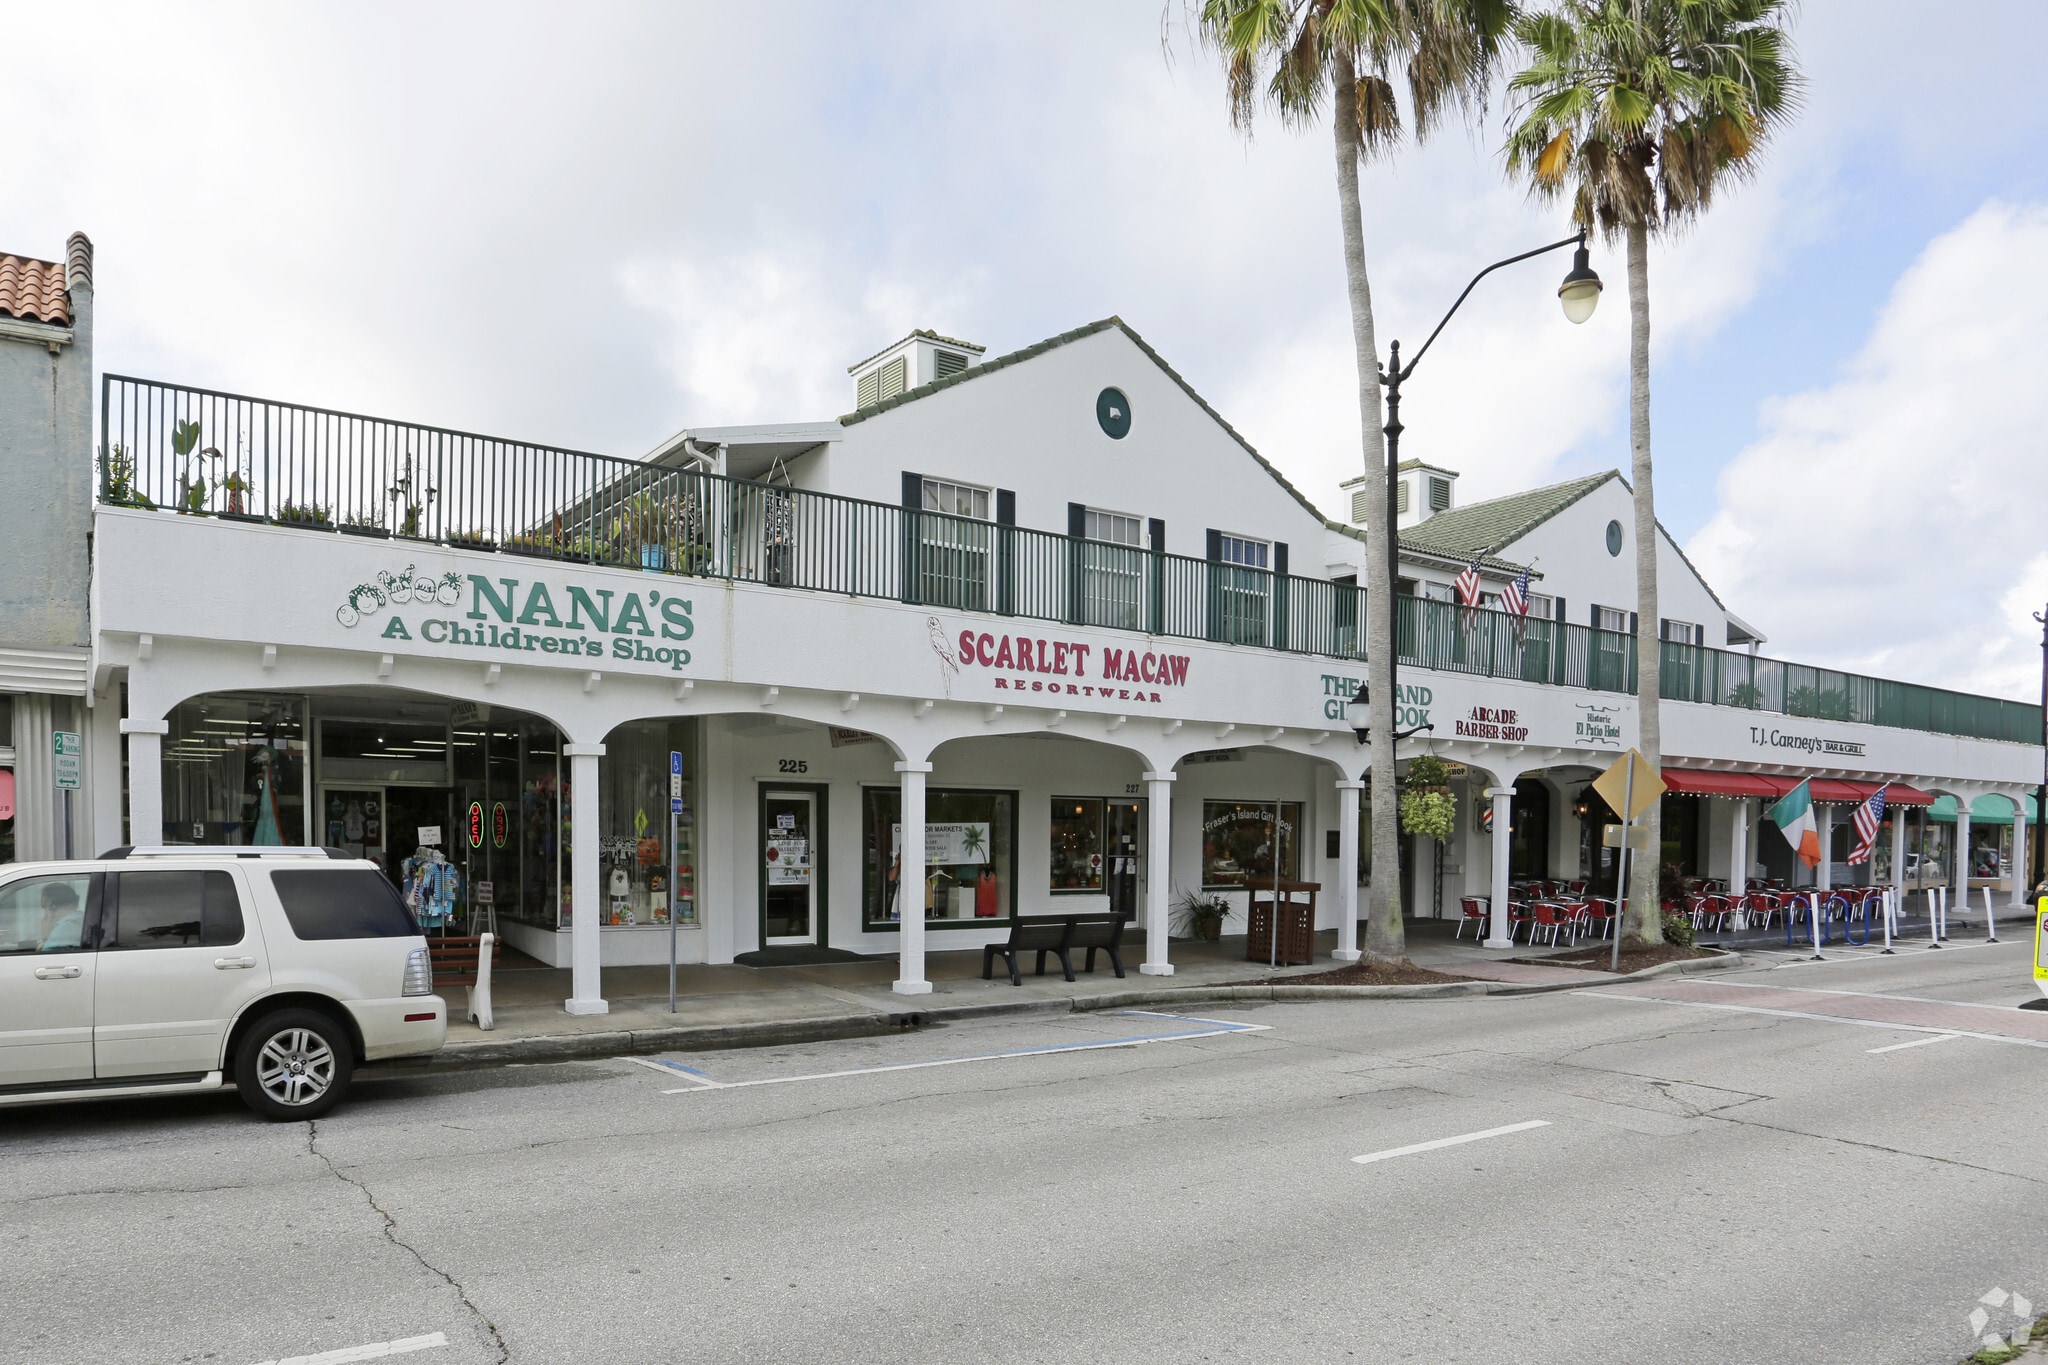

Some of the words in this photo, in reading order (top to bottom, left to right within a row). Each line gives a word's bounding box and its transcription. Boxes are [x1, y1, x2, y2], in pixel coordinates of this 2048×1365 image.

[466, 573, 694, 641] NANA'S
[381, 616, 412, 641] A
[420, 618, 604, 657] Children's
[612, 636, 692, 671] Shop
[959, 630, 1090, 677] SCARLET
[1103, 647, 1190, 687] MACAW
[995, 677, 1162, 703] RESORTWEAR
[1321, 674, 1359, 698] THE
[1396, 705, 1431, 727] OOK
[1471, 705, 1517, 725] ARCADE
[1587, 713, 1611, 724] Historic
[1576, 722, 1584, 735] El
[1586, 722, 1603, 737] Patio
[1604, 724, 1621, 738] Hotel
[55, 736, 62, 750] 2
[1770, 729, 1822, 755] Carney's
[1825, 742, 1838, 752] BAR
[1839, 744, 1844, 752] &
[1844, 744, 1863, 754] GRILL
[778, 759, 808, 774] 225
[1125, 784, 1140, 793] 227
[471, 805, 480, 845] OPEN
[1205, 811, 1236, 832] Fraser's
[1237, 809, 1260, 820] Island
[1261, 811, 1274, 823] Gift
